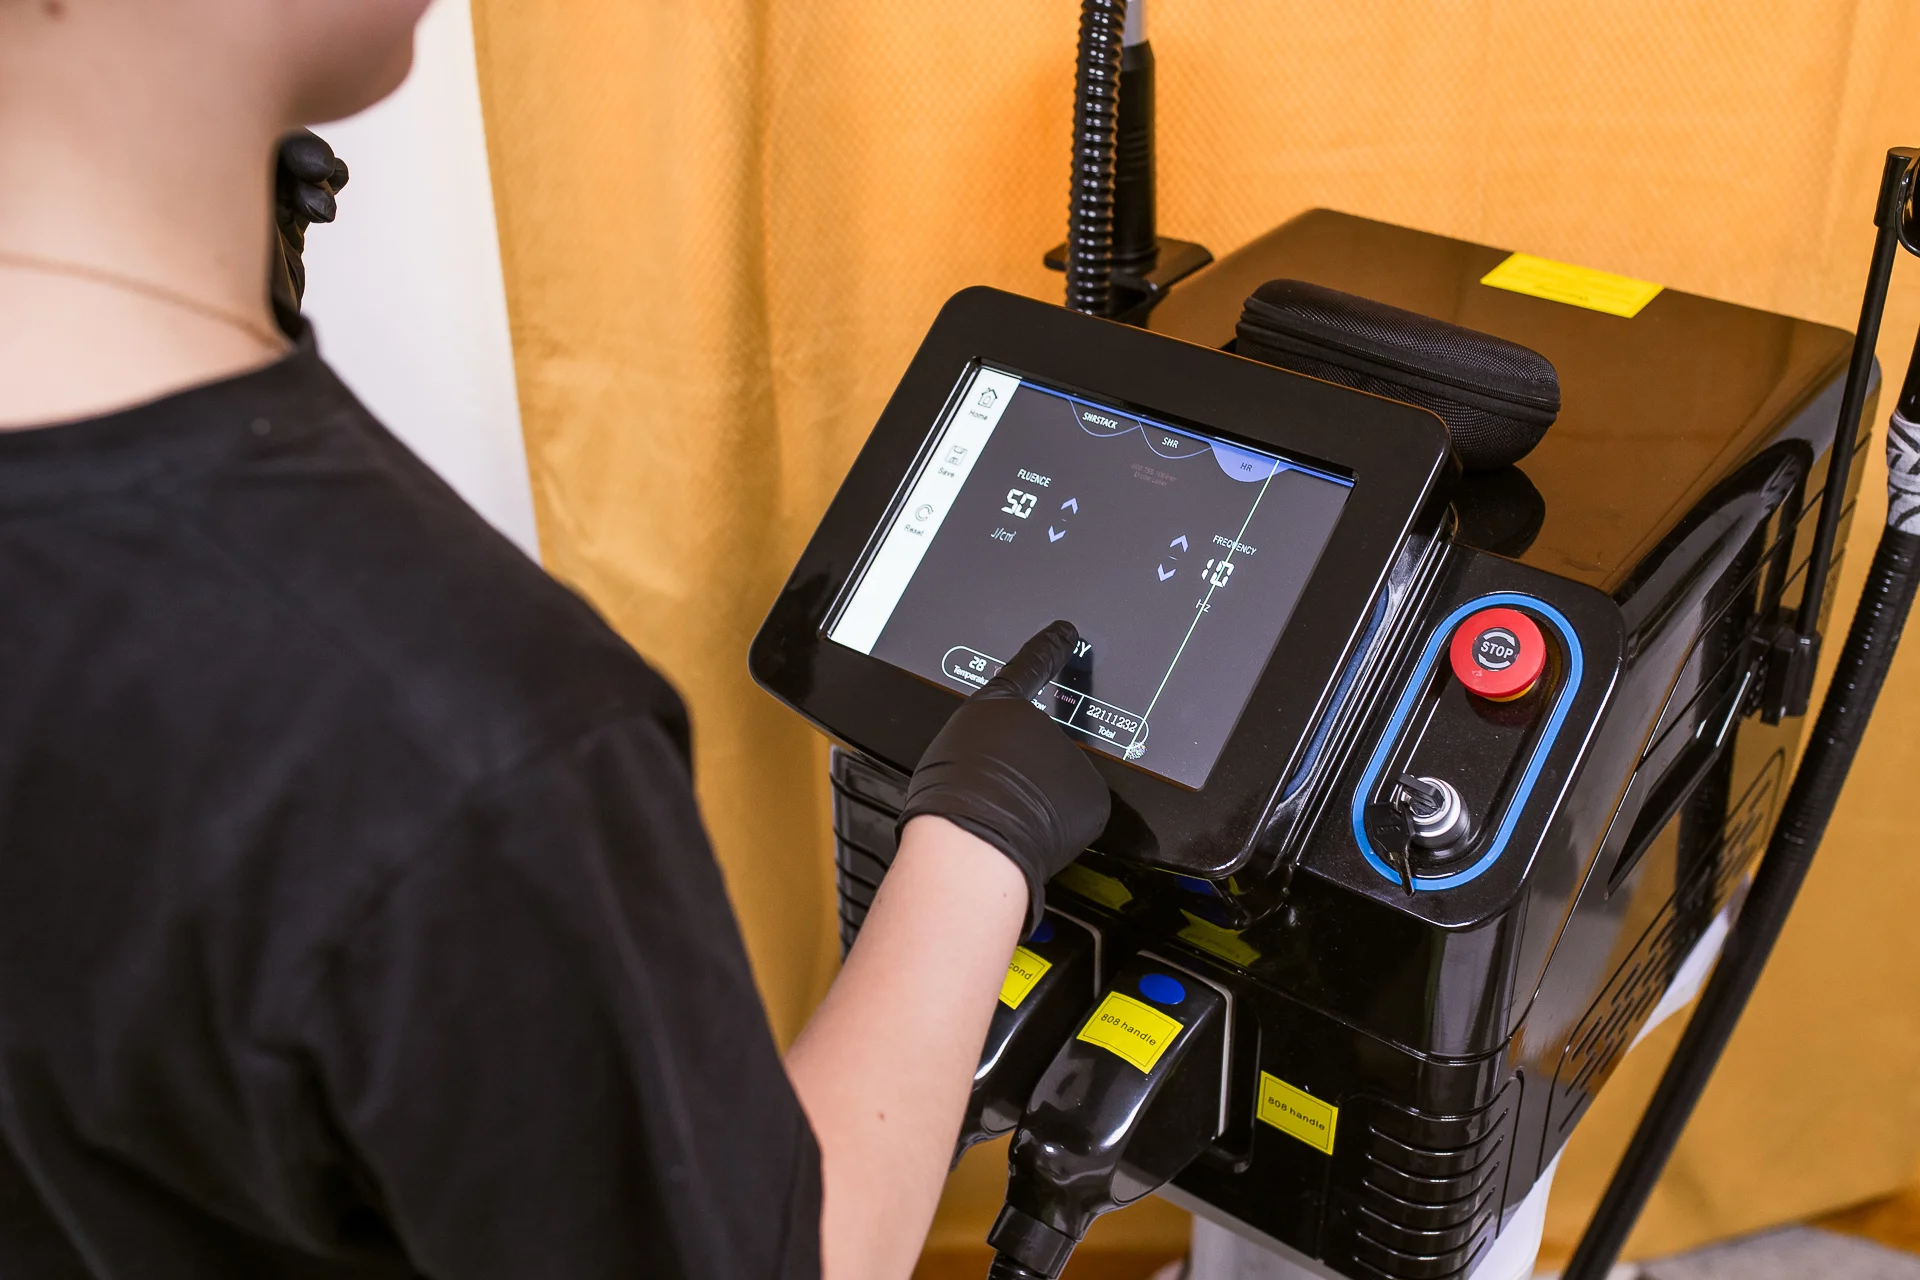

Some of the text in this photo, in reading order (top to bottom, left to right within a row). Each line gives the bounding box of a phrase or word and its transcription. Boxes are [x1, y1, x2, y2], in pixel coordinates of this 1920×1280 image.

[969, 409, 988, 421] Home
[1082, 411, 1119, 430] SHRSTACK
[1161, 436, 1179, 449] SHR
[938, 467, 955, 478] Save
[1240, 462, 1253, 472] HR
[1017, 468, 1052, 487] FLUENCE
[1001, 488, 1038, 519] 50
[904, 523, 925, 537] Reset
[1201, 558, 1235, 588] 10
[1195, 598, 1212, 613] Hz
[1480, 641, 1514, 659] STOP
[968, 655, 987, 672] 28
[1086, 704, 1138, 733] 22111232
[1098, 725, 1117, 740] Total
[1100, 1013, 1157, 1047] 808 handle
[1267, 1096, 1326, 1131] 808 handle
